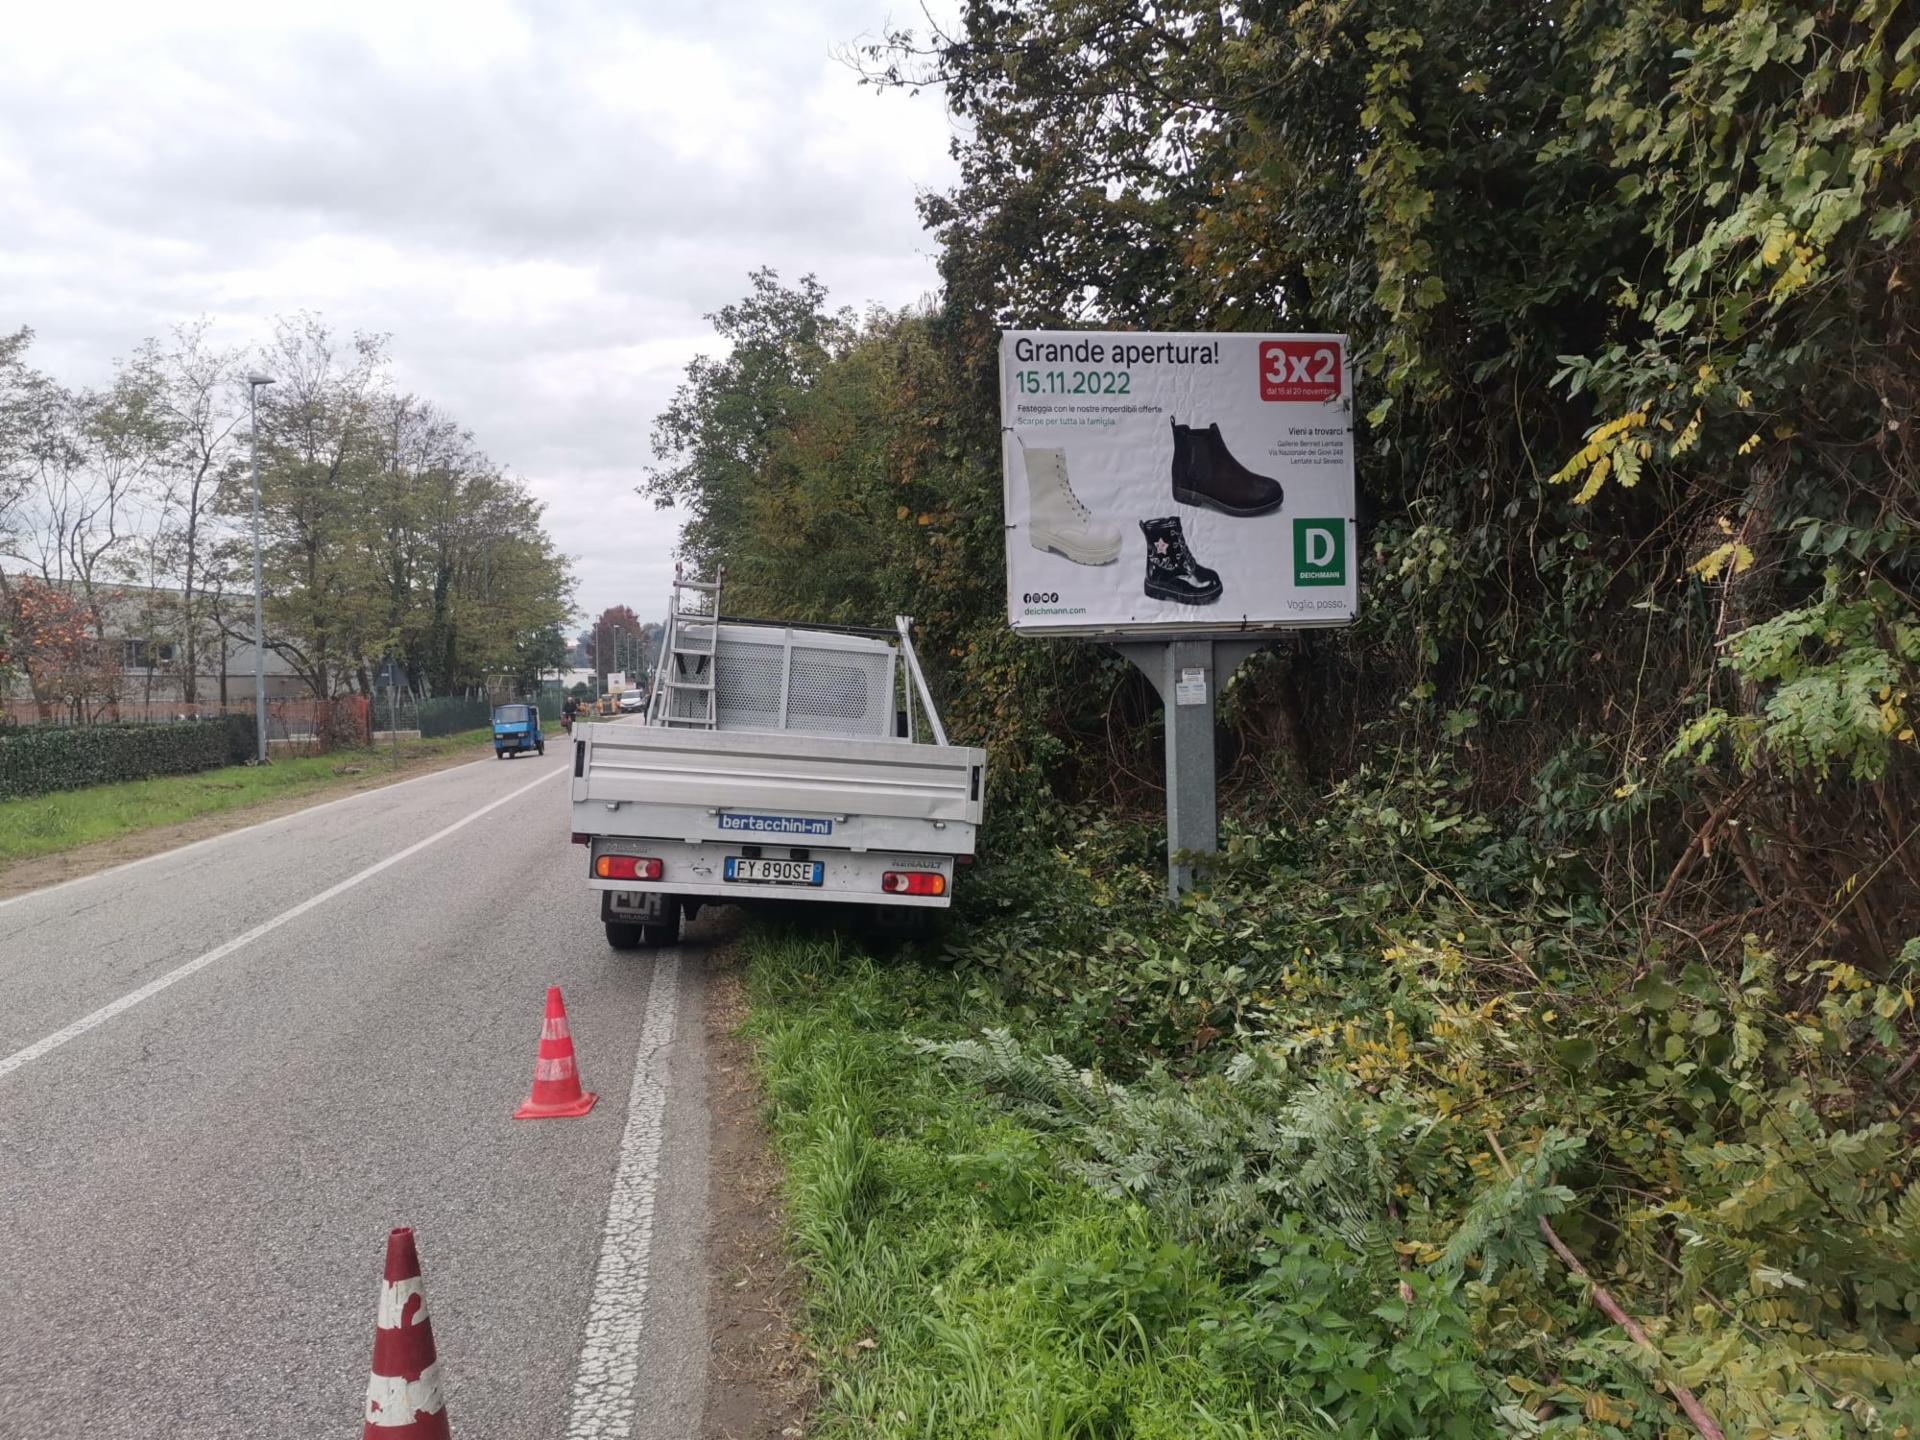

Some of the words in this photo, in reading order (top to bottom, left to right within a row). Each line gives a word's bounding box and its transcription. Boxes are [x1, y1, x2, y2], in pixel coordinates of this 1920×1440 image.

[1016, 338, 1105, 363] Grande
[1112, 341, 1219, 369] apertura!
[1265, 348, 1335, 384] 3x2
[1016, 371, 1131, 395] 15.11.2022
[1266, 387, 1277, 395] dal
[1286, 387, 1292, 395] al
[1017, 404, 1052, 414] Festeggia
[1069, 404, 1075, 413] le
[1077, 405, 1100, 413] nostre
[1101, 405, 1137, 414] imperdibili
[1017, 417, 1043, 426] Scarpe
[1046, 418, 1057, 426] per
[1060, 417, 1077, 425] tutta
[1079, 417, 1086, 425] la
[1289, 427, 1307, 436] Vieni
[1314, 427, 1343, 436] trovarci
[1305, 528, 1335, 567] D
[1299, 571, 1340, 579] DEICHMANN
[1024, 607, 1087, 616] deichmann.com
[722, 814, 829, 834] bertacchini-mi
[891, 861, 943, 869] RENAULT
[737, 860, 757, 878] FY
[762, 861, 813, 881] 890SE
[619, 912, 649, 920] MILANO
